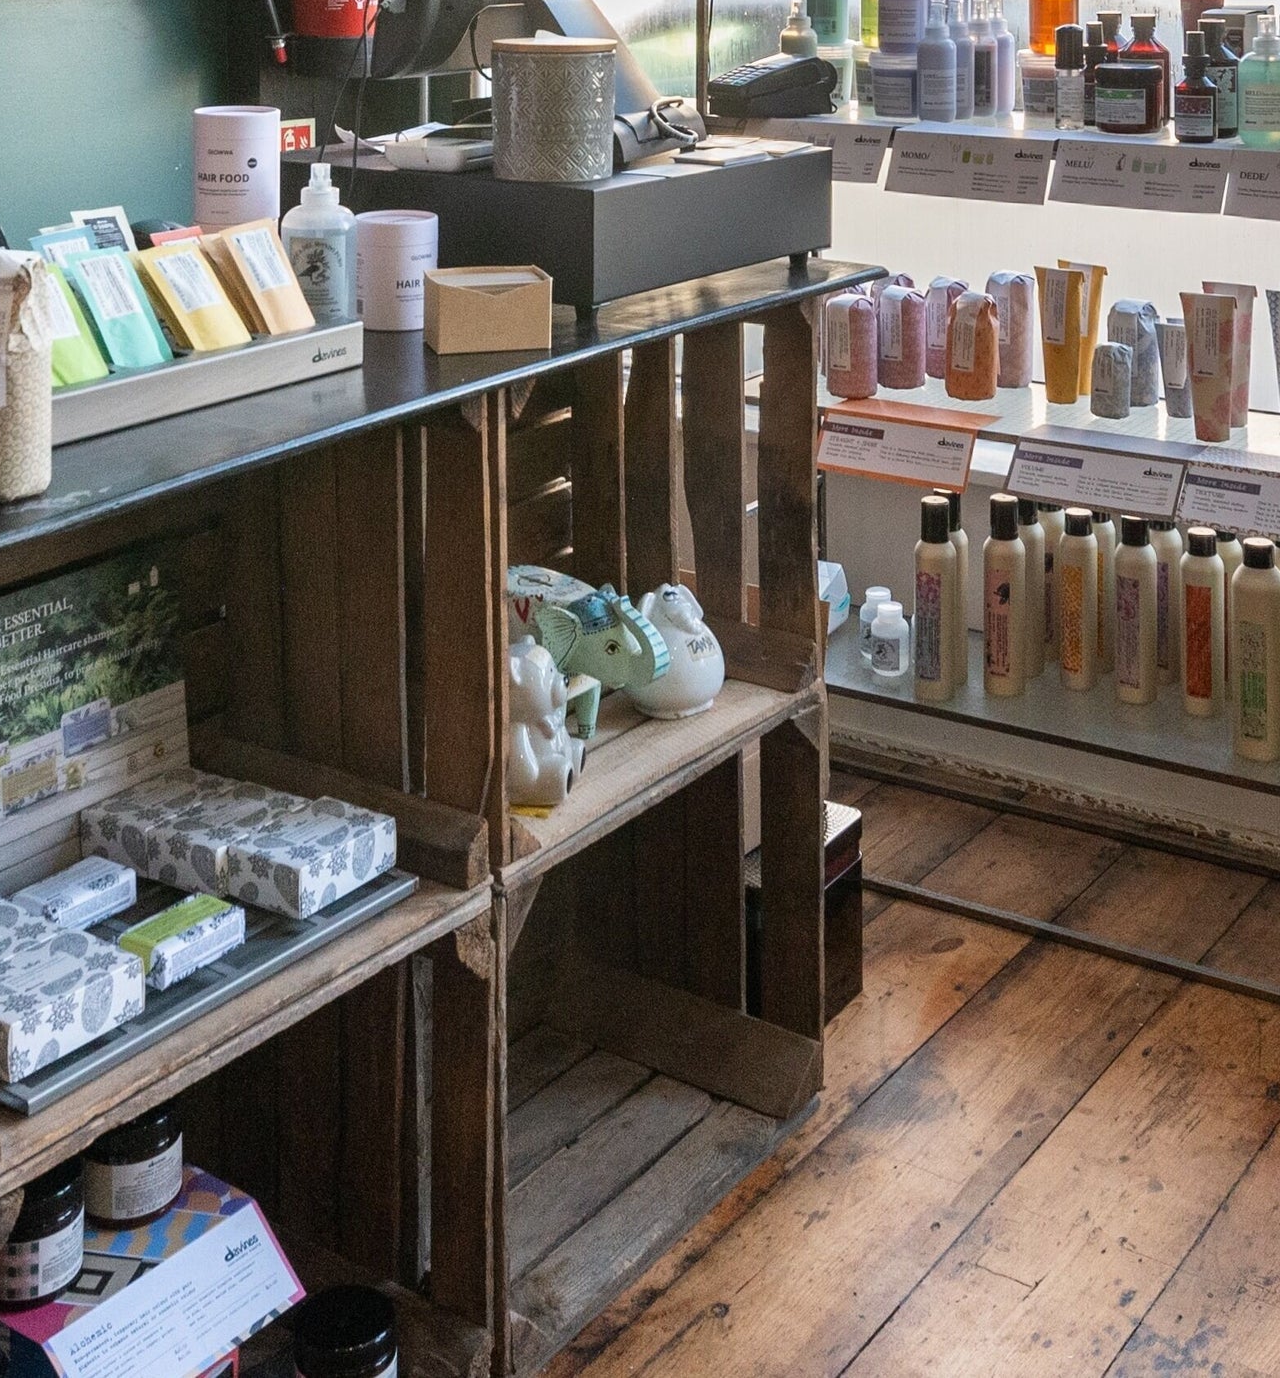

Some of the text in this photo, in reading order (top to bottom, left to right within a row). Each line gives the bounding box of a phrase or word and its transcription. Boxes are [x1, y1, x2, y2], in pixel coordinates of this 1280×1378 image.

[854, 134, 881, 144] davines
[900, 151, 931, 160] MOMO/
[1014, 148, 1043, 160] davines
[1065, 159, 1095, 169] MELU/
[1188, 158, 1221, 169] davines
[198, 172, 250, 183] HAIR FOOD
[1239, 171, 1270, 182] DEDE/
[396, 280, 420, 289] HAIR
[312, 344, 347, 363] davines
[937, 437, 964, 449] davines
[1143, 467, 1173, 479] davines
[4, 597, 74, 631] ESSENTIAL,
[0, 652, 42, 675] Essential
[42, 640, 82, 662] Haircare
[0, 689, 23, 706] Food
[224, 1233, 260, 1263] davines
[69, 1322, 113, 1356] Alchemic
